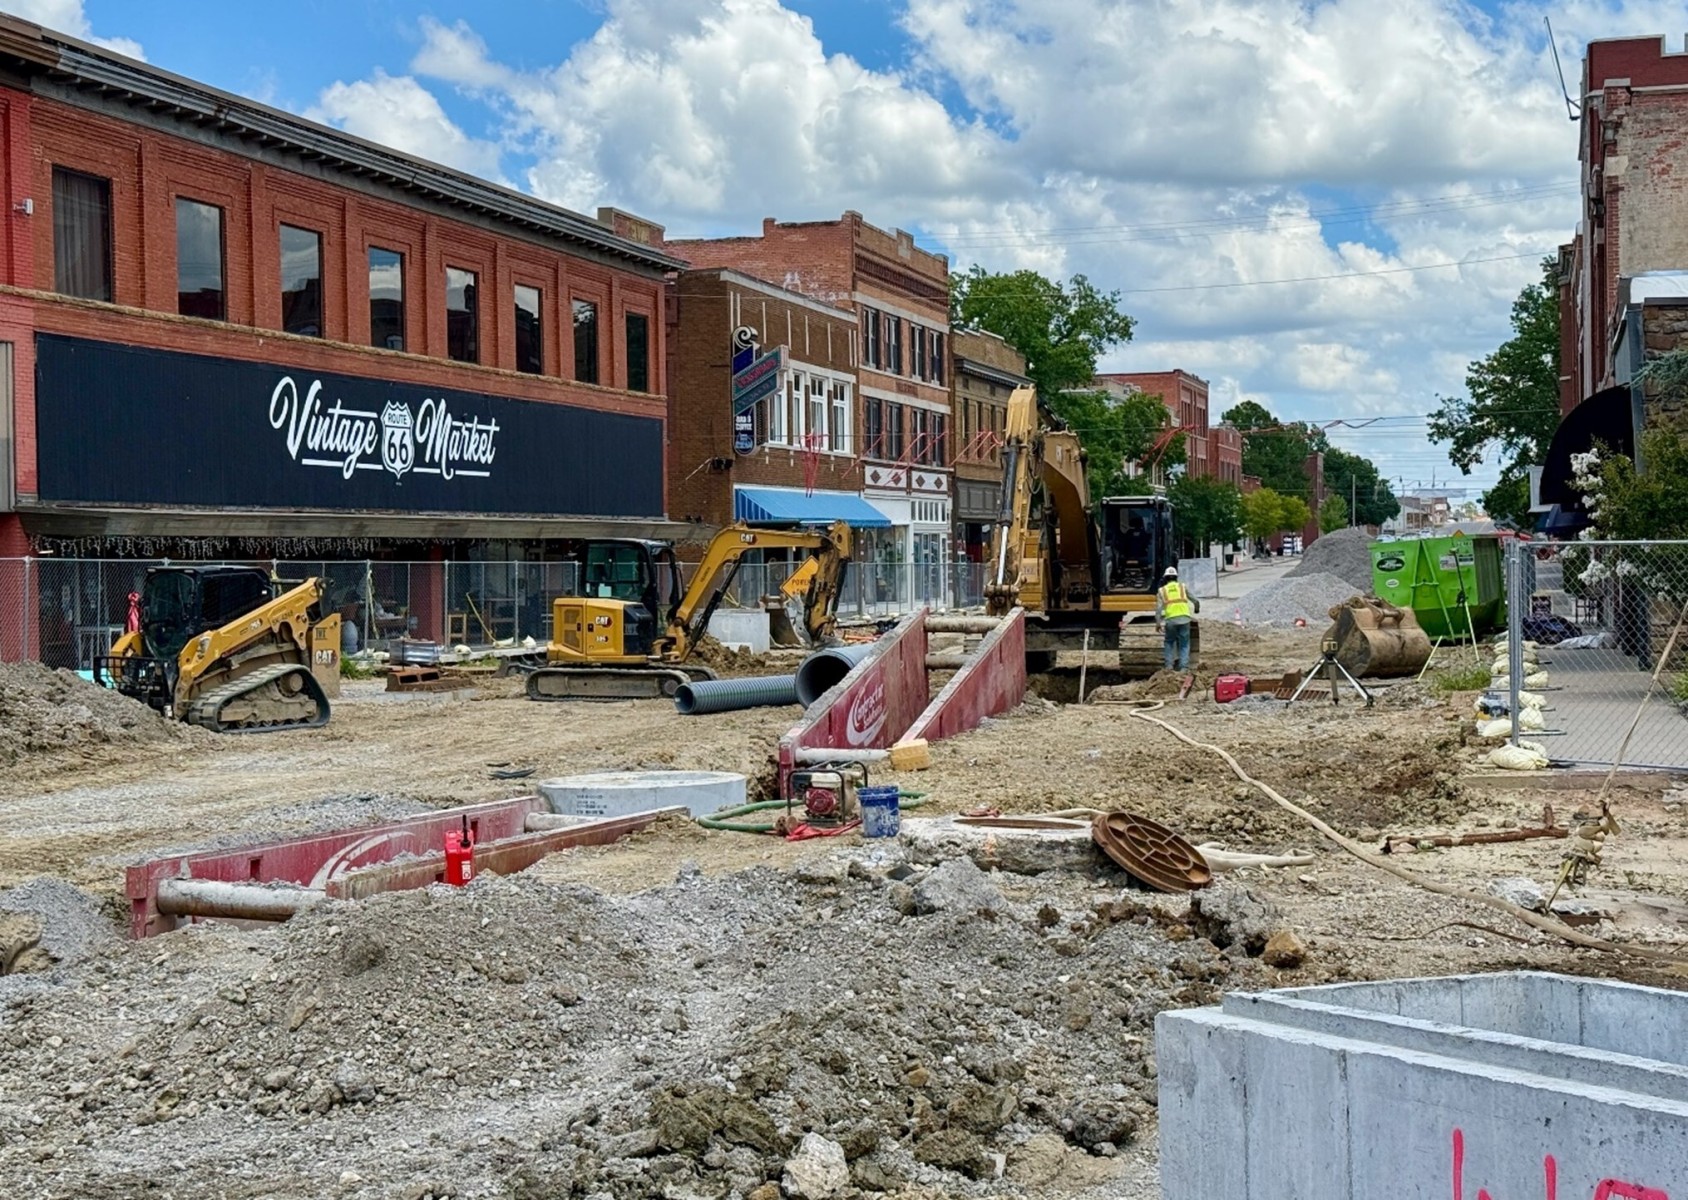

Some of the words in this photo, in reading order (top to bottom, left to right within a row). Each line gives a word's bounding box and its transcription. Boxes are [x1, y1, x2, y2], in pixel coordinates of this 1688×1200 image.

[387, 412, 408, 425] ROUTE
[269, 376, 378, 479] Vintage
[416, 398, 500, 480] Market
[385, 429, 409, 465] 66
[740, 533, 754, 543] CAT
[595, 616, 609, 625] CAT
[315, 649, 334, 665] CAT
